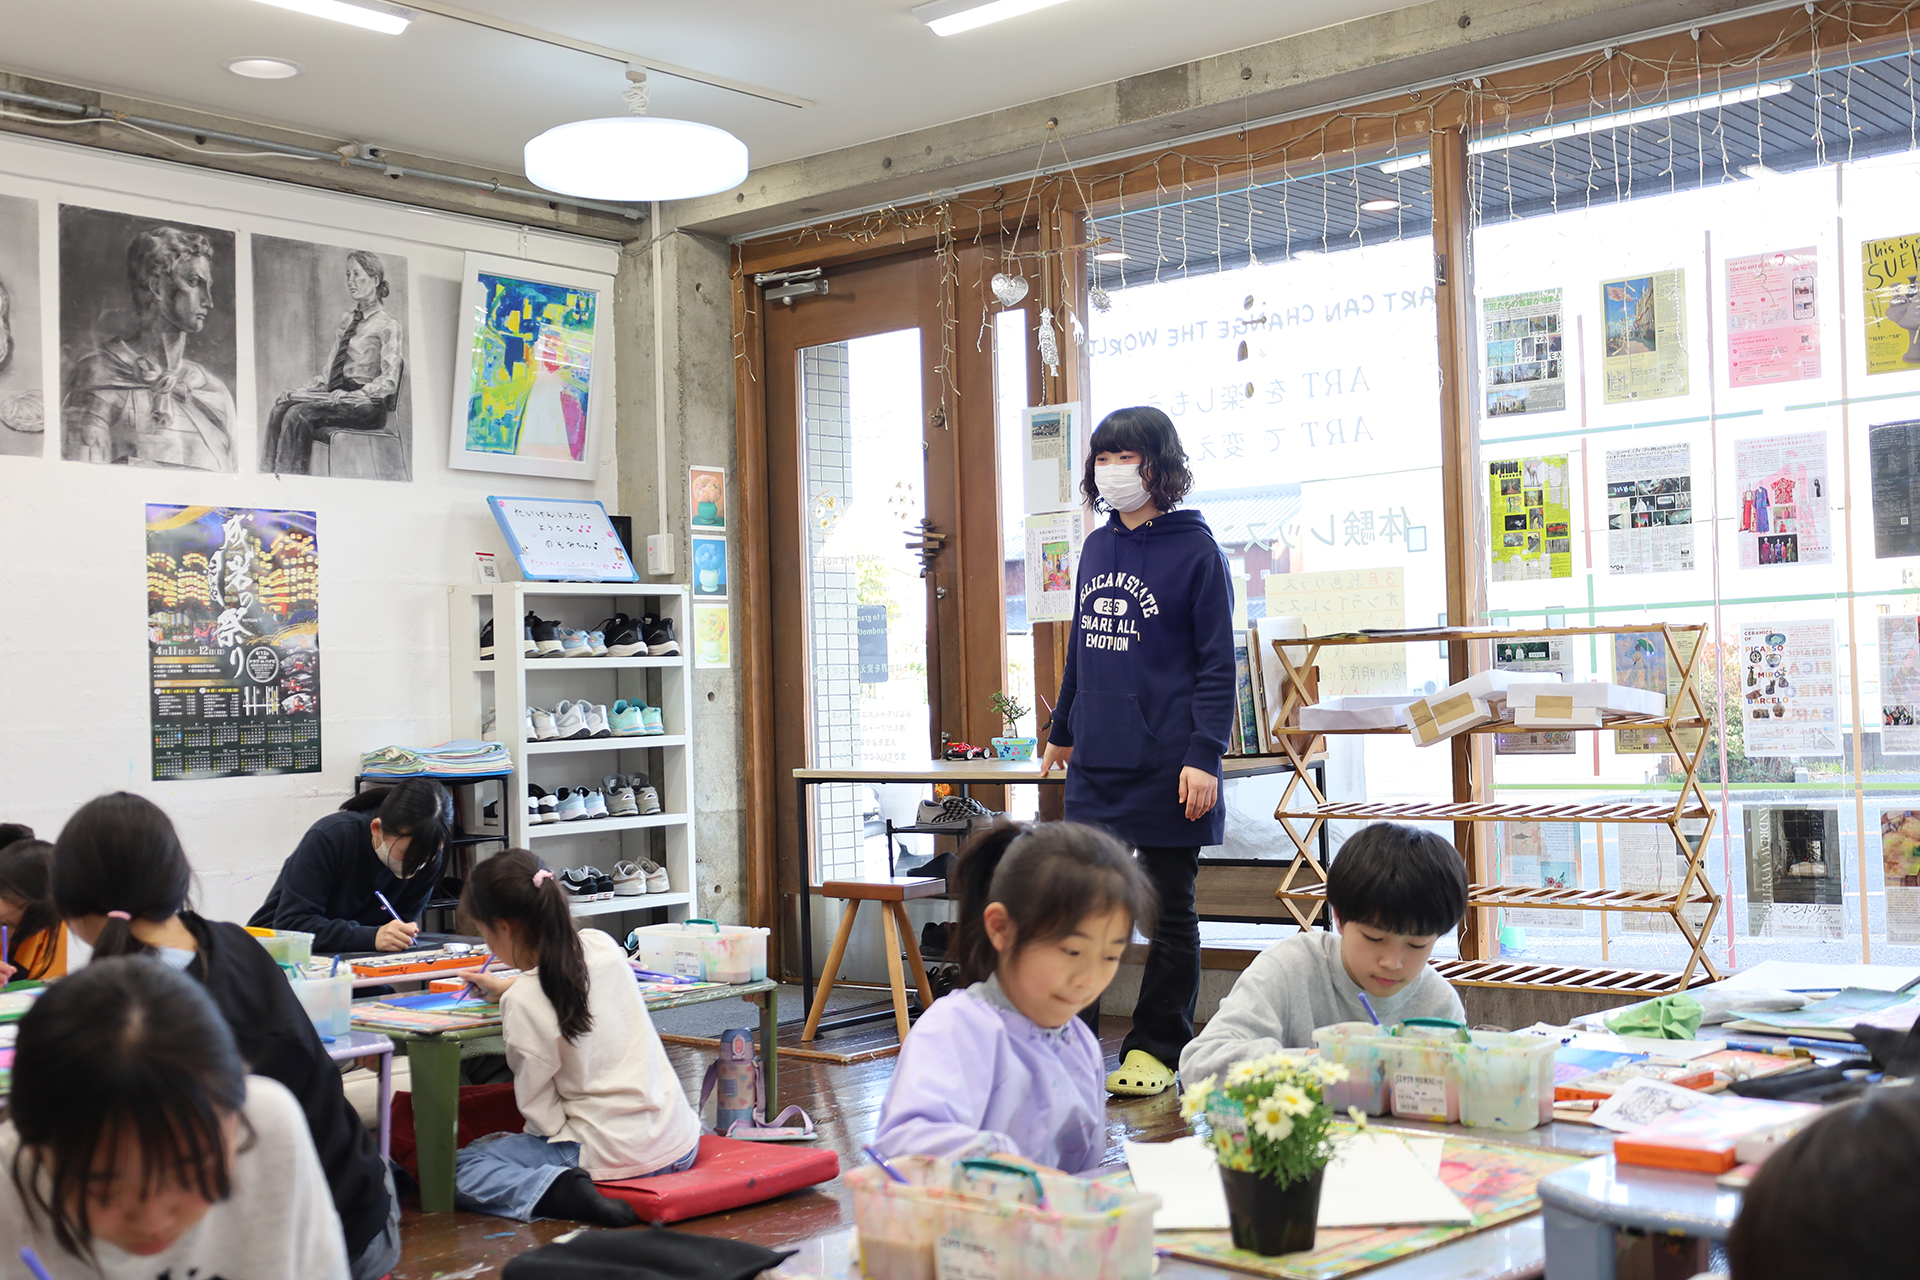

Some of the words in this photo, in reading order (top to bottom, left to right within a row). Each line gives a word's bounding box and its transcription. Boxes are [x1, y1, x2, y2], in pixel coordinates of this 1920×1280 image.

[1080, 614, 1113, 633] SHARE
[1116, 618, 1138, 635] ALL
[1085, 633, 1129, 652] EMOTION
[1745, 644, 1784, 653] PICASSO
